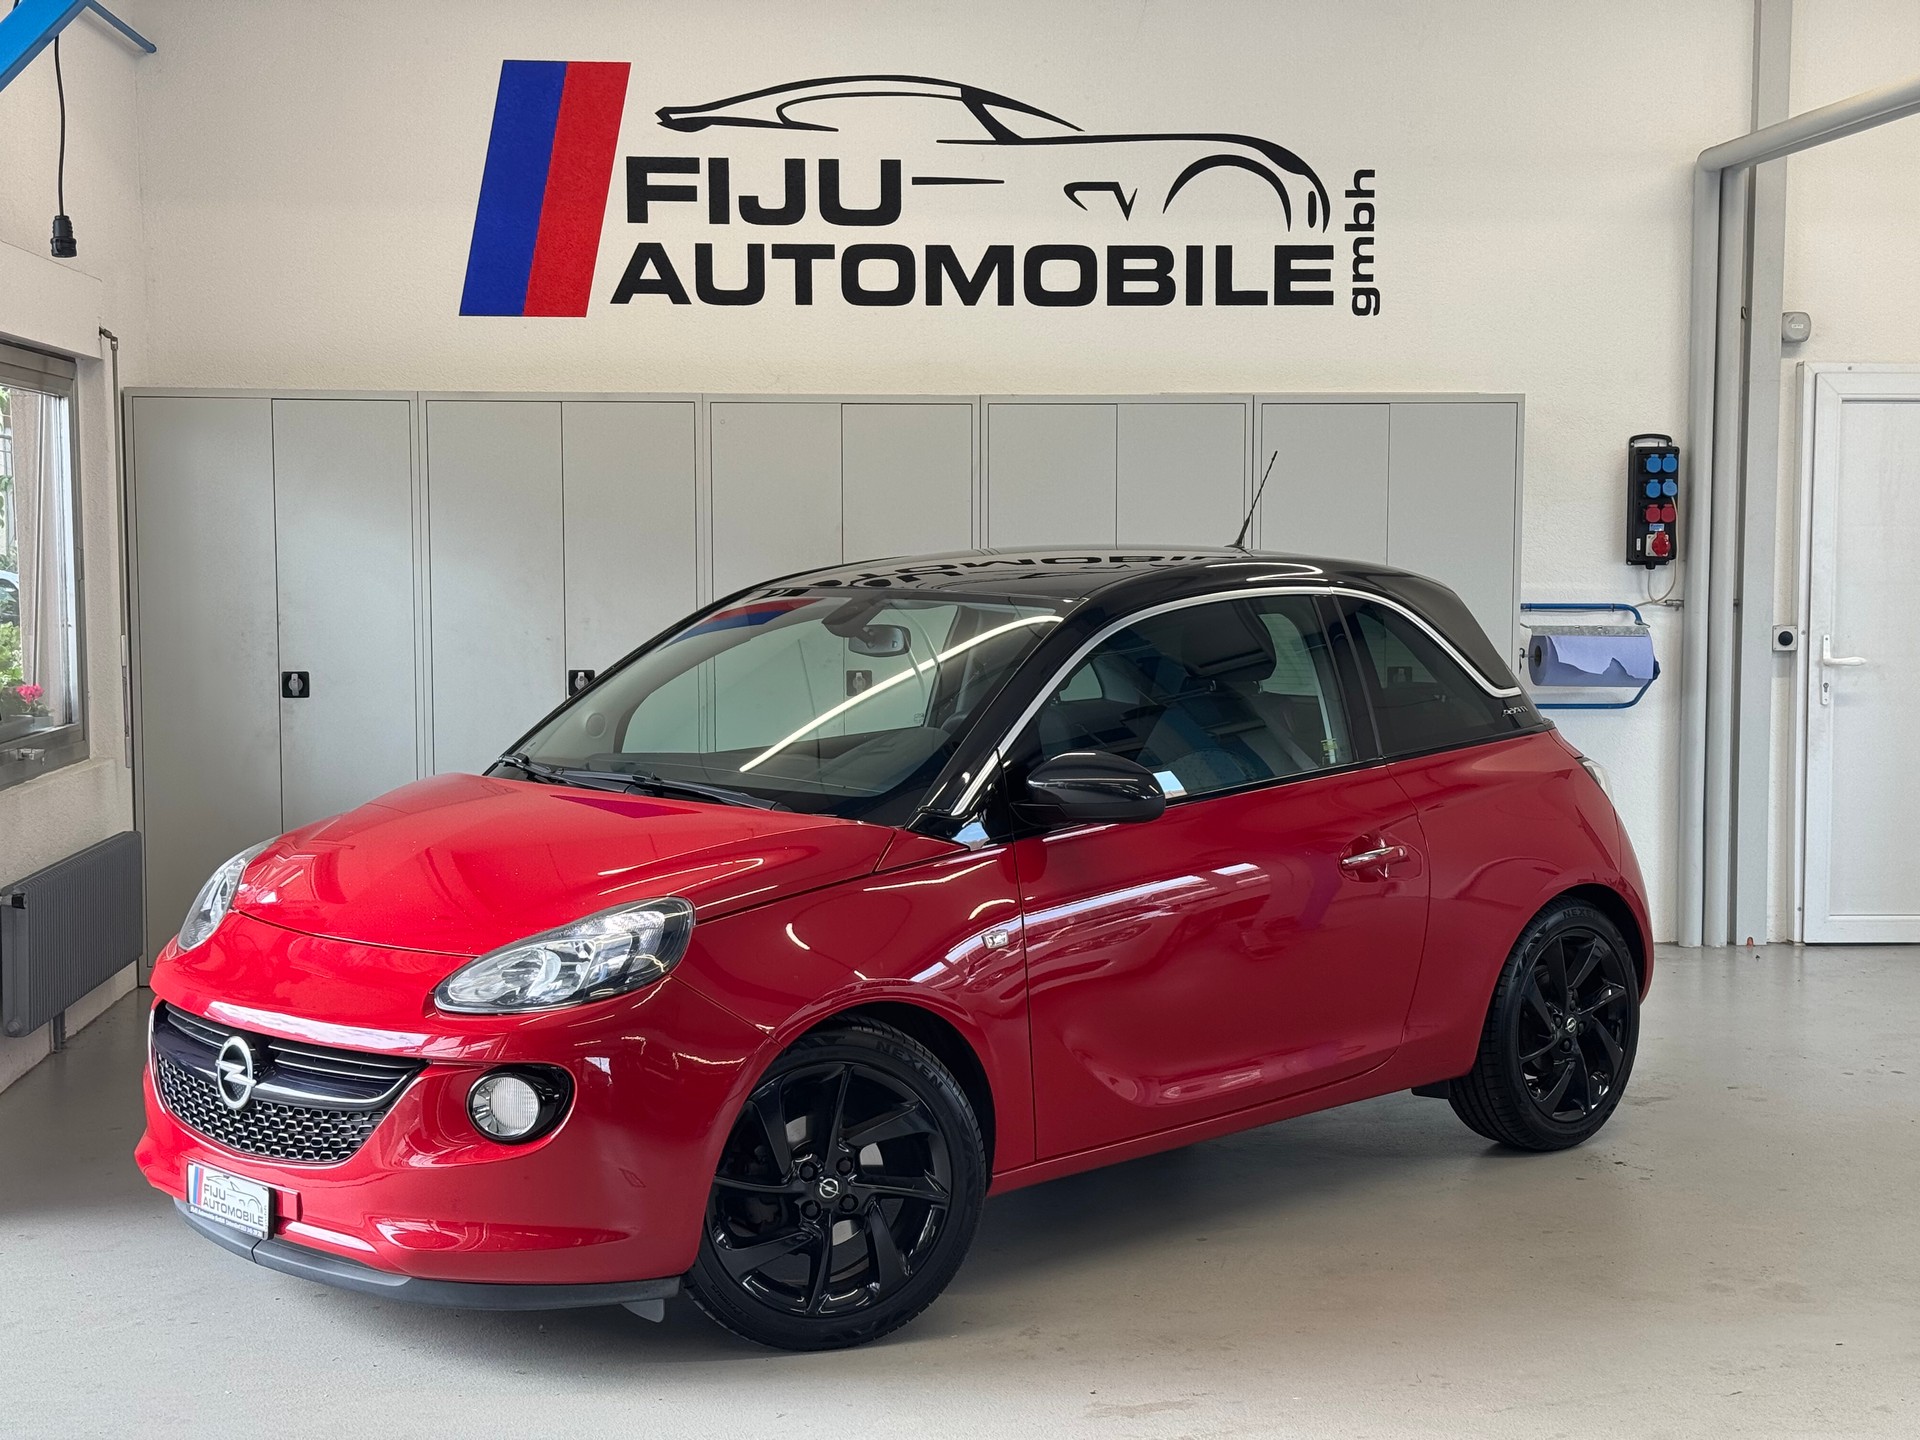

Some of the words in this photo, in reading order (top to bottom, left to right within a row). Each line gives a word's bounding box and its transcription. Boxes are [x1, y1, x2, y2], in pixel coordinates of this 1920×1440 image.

[625, 156, 902, 227] FIJU
[1344, 169, 1381, 317] gmbh
[610, 242, 1335, 307] AUTOMOBILE
[877, 1042, 943, 1089] NEXEN
[203, 1183, 226, 1201] FIJU
[203, 1197, 264, 1227] AUTOMOBILE
